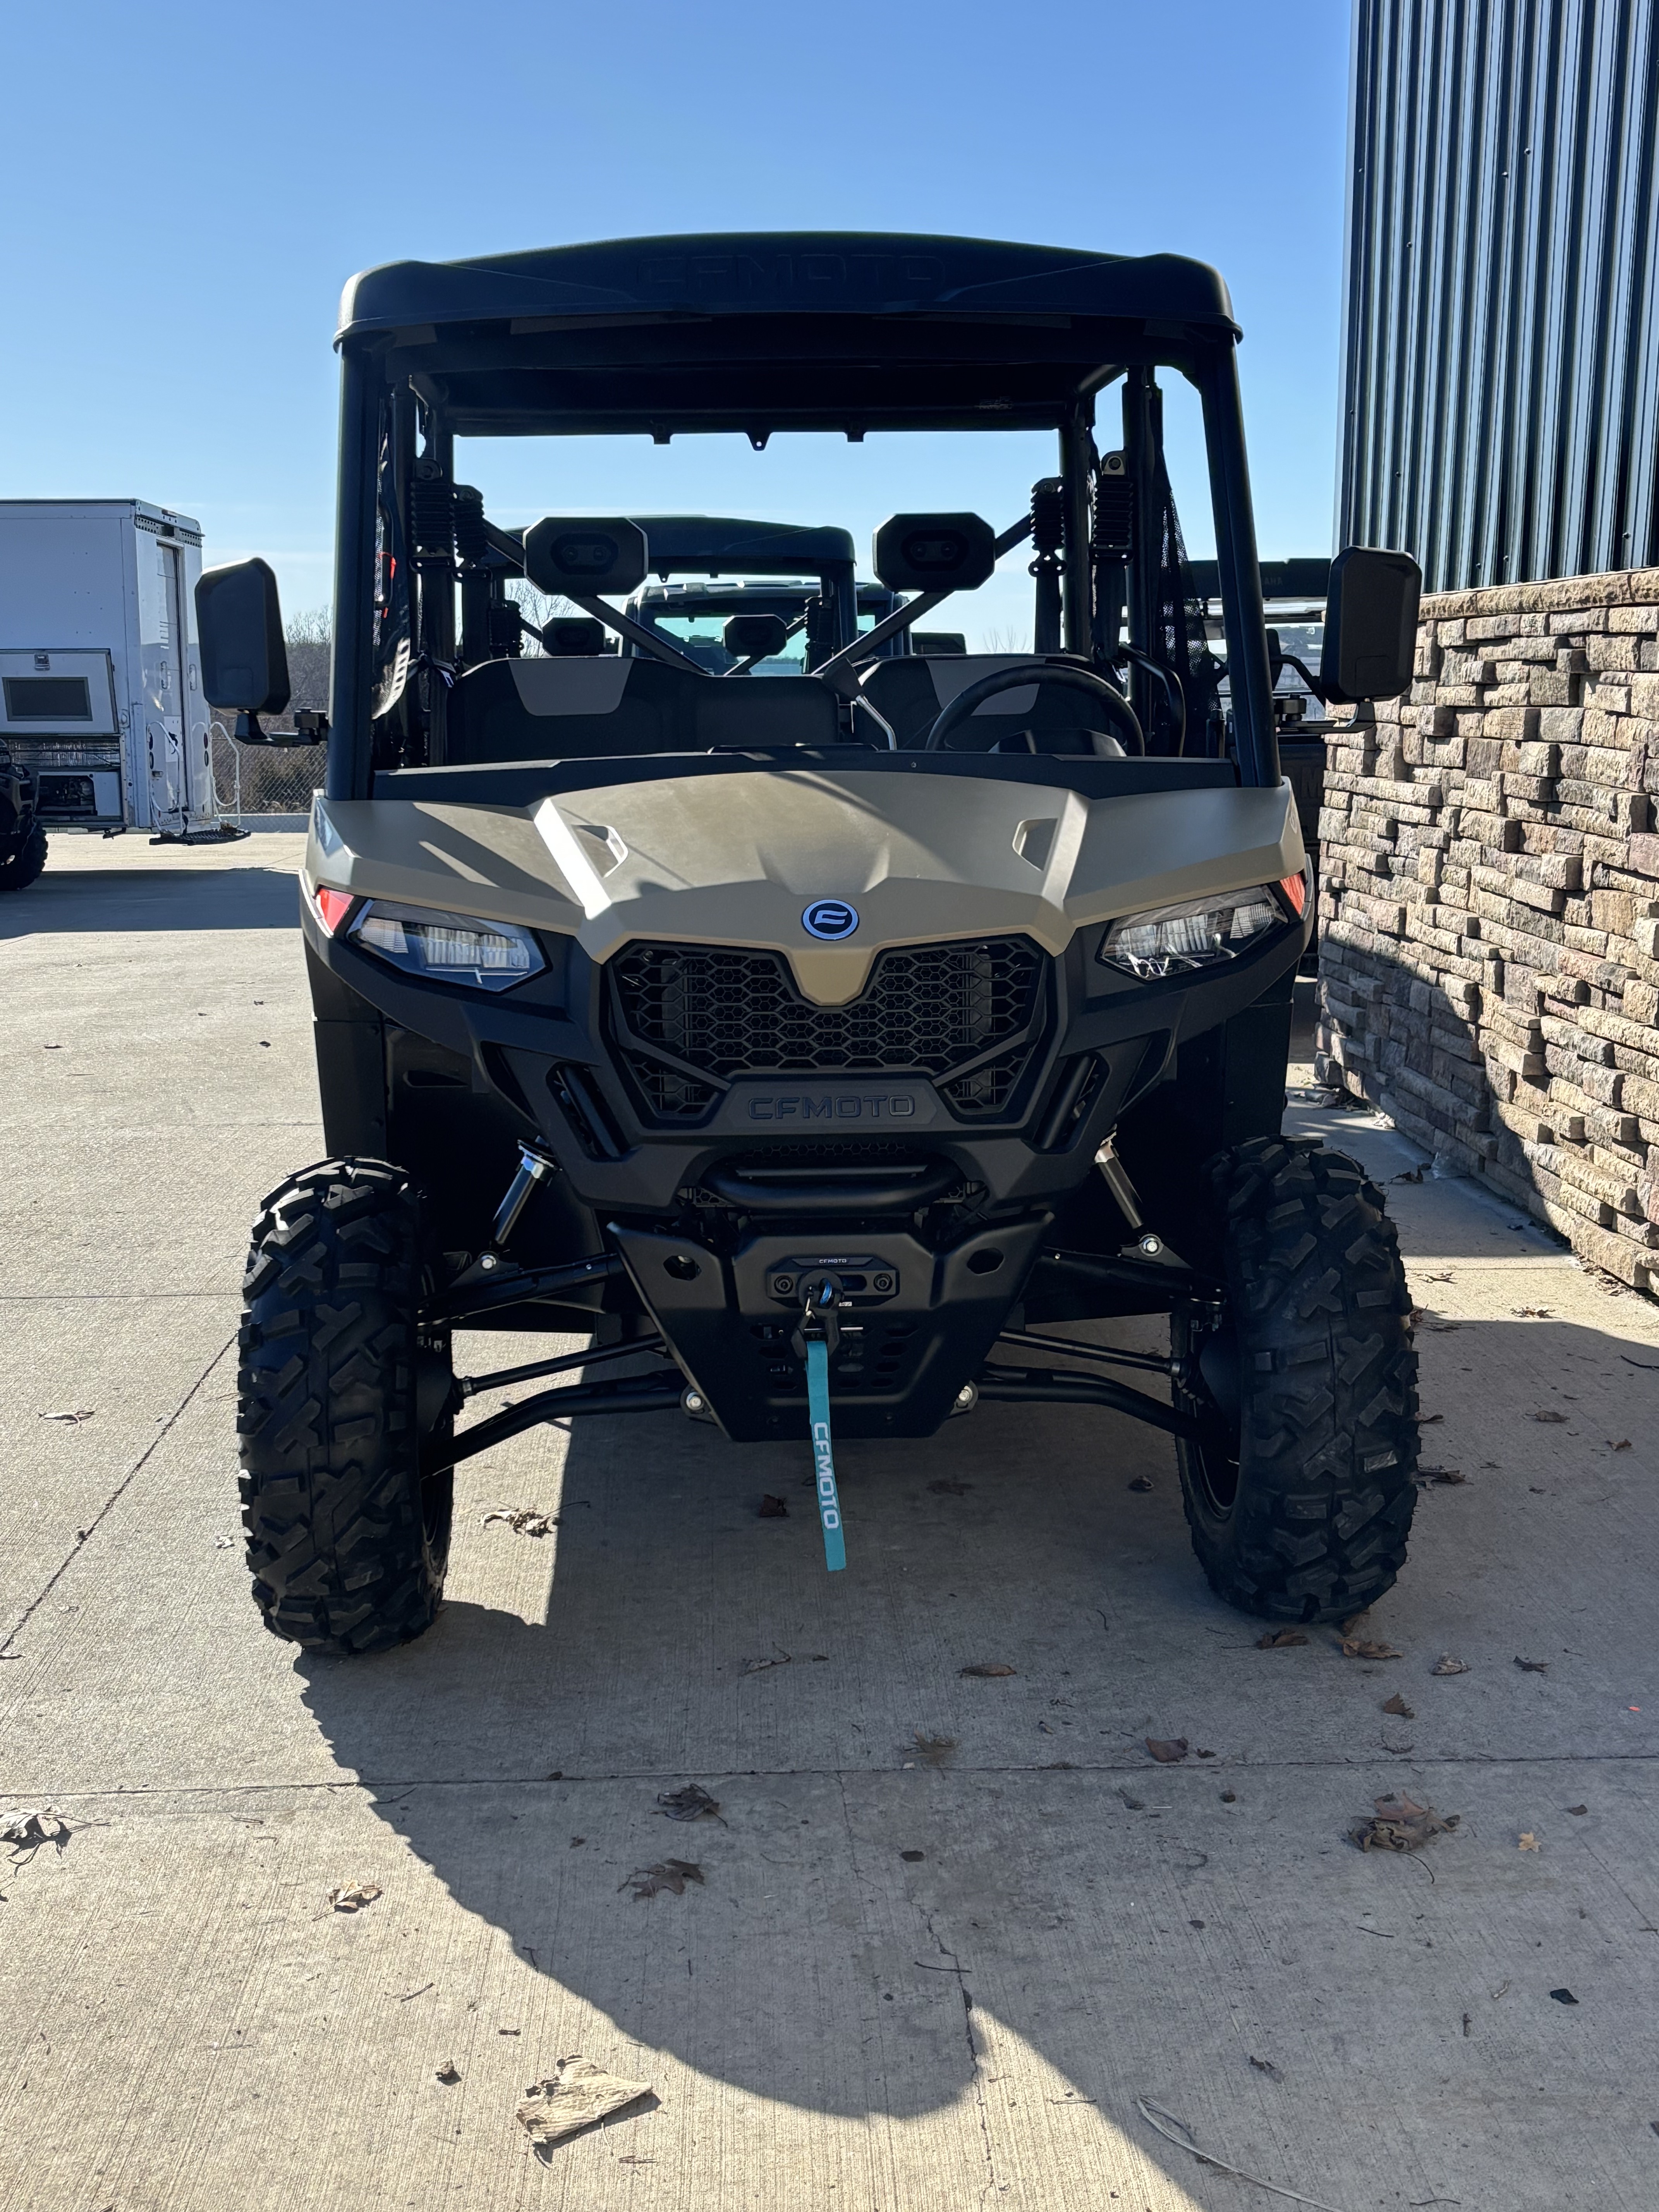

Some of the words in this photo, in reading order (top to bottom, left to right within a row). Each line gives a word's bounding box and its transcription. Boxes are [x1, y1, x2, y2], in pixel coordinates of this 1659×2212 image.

[637, 254, 946, 289] CFMOTO
[749, 1095, 915, 1119] CFMOTO
[814, 1422, 839, 1529] CFMOTO
